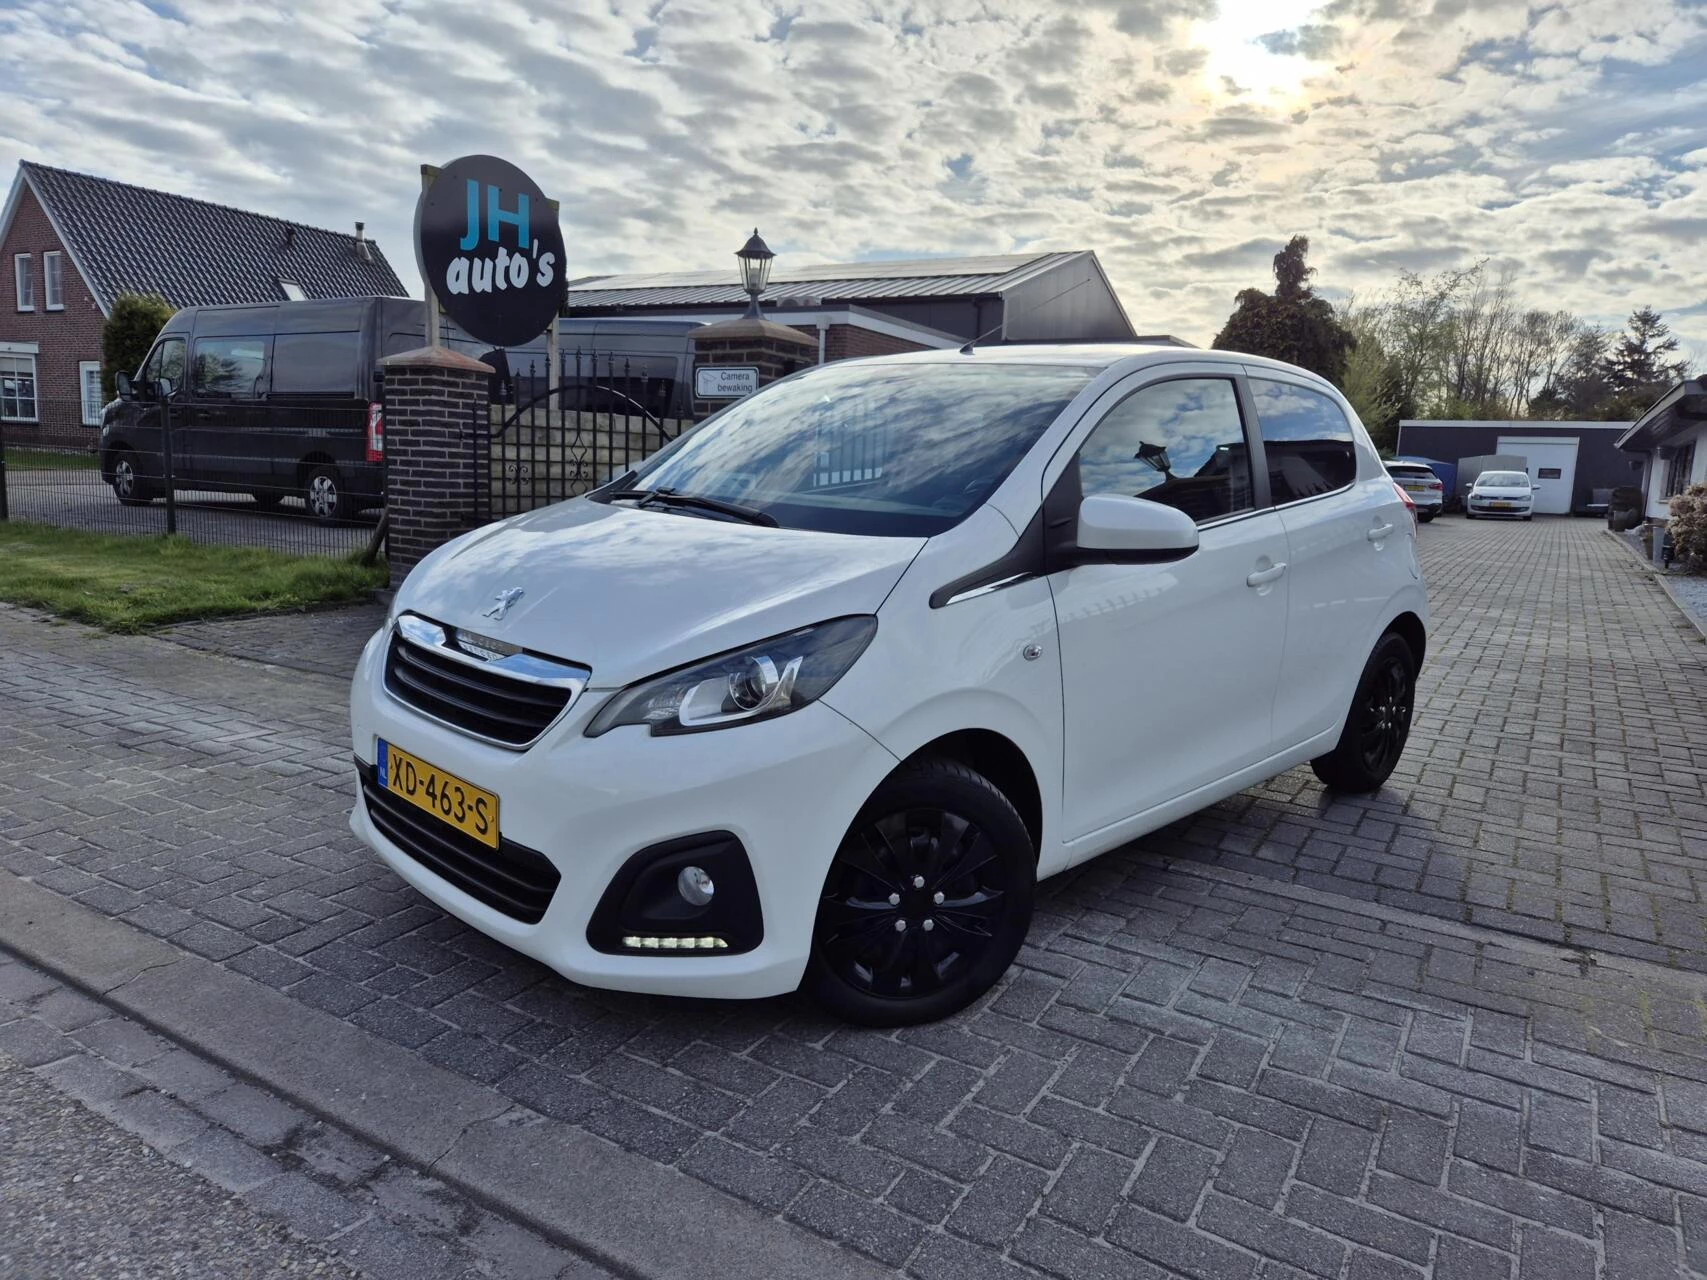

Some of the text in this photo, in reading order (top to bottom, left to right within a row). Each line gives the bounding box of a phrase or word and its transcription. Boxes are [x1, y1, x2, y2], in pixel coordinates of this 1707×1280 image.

[460, 178, 530, 251] JH
[446, 238, 555, 295] auto's
[717, 383, 753, 394] bewaking
[720, 371, 750, 381] Camera
[392, 753, 489, 835] XD-463-S
